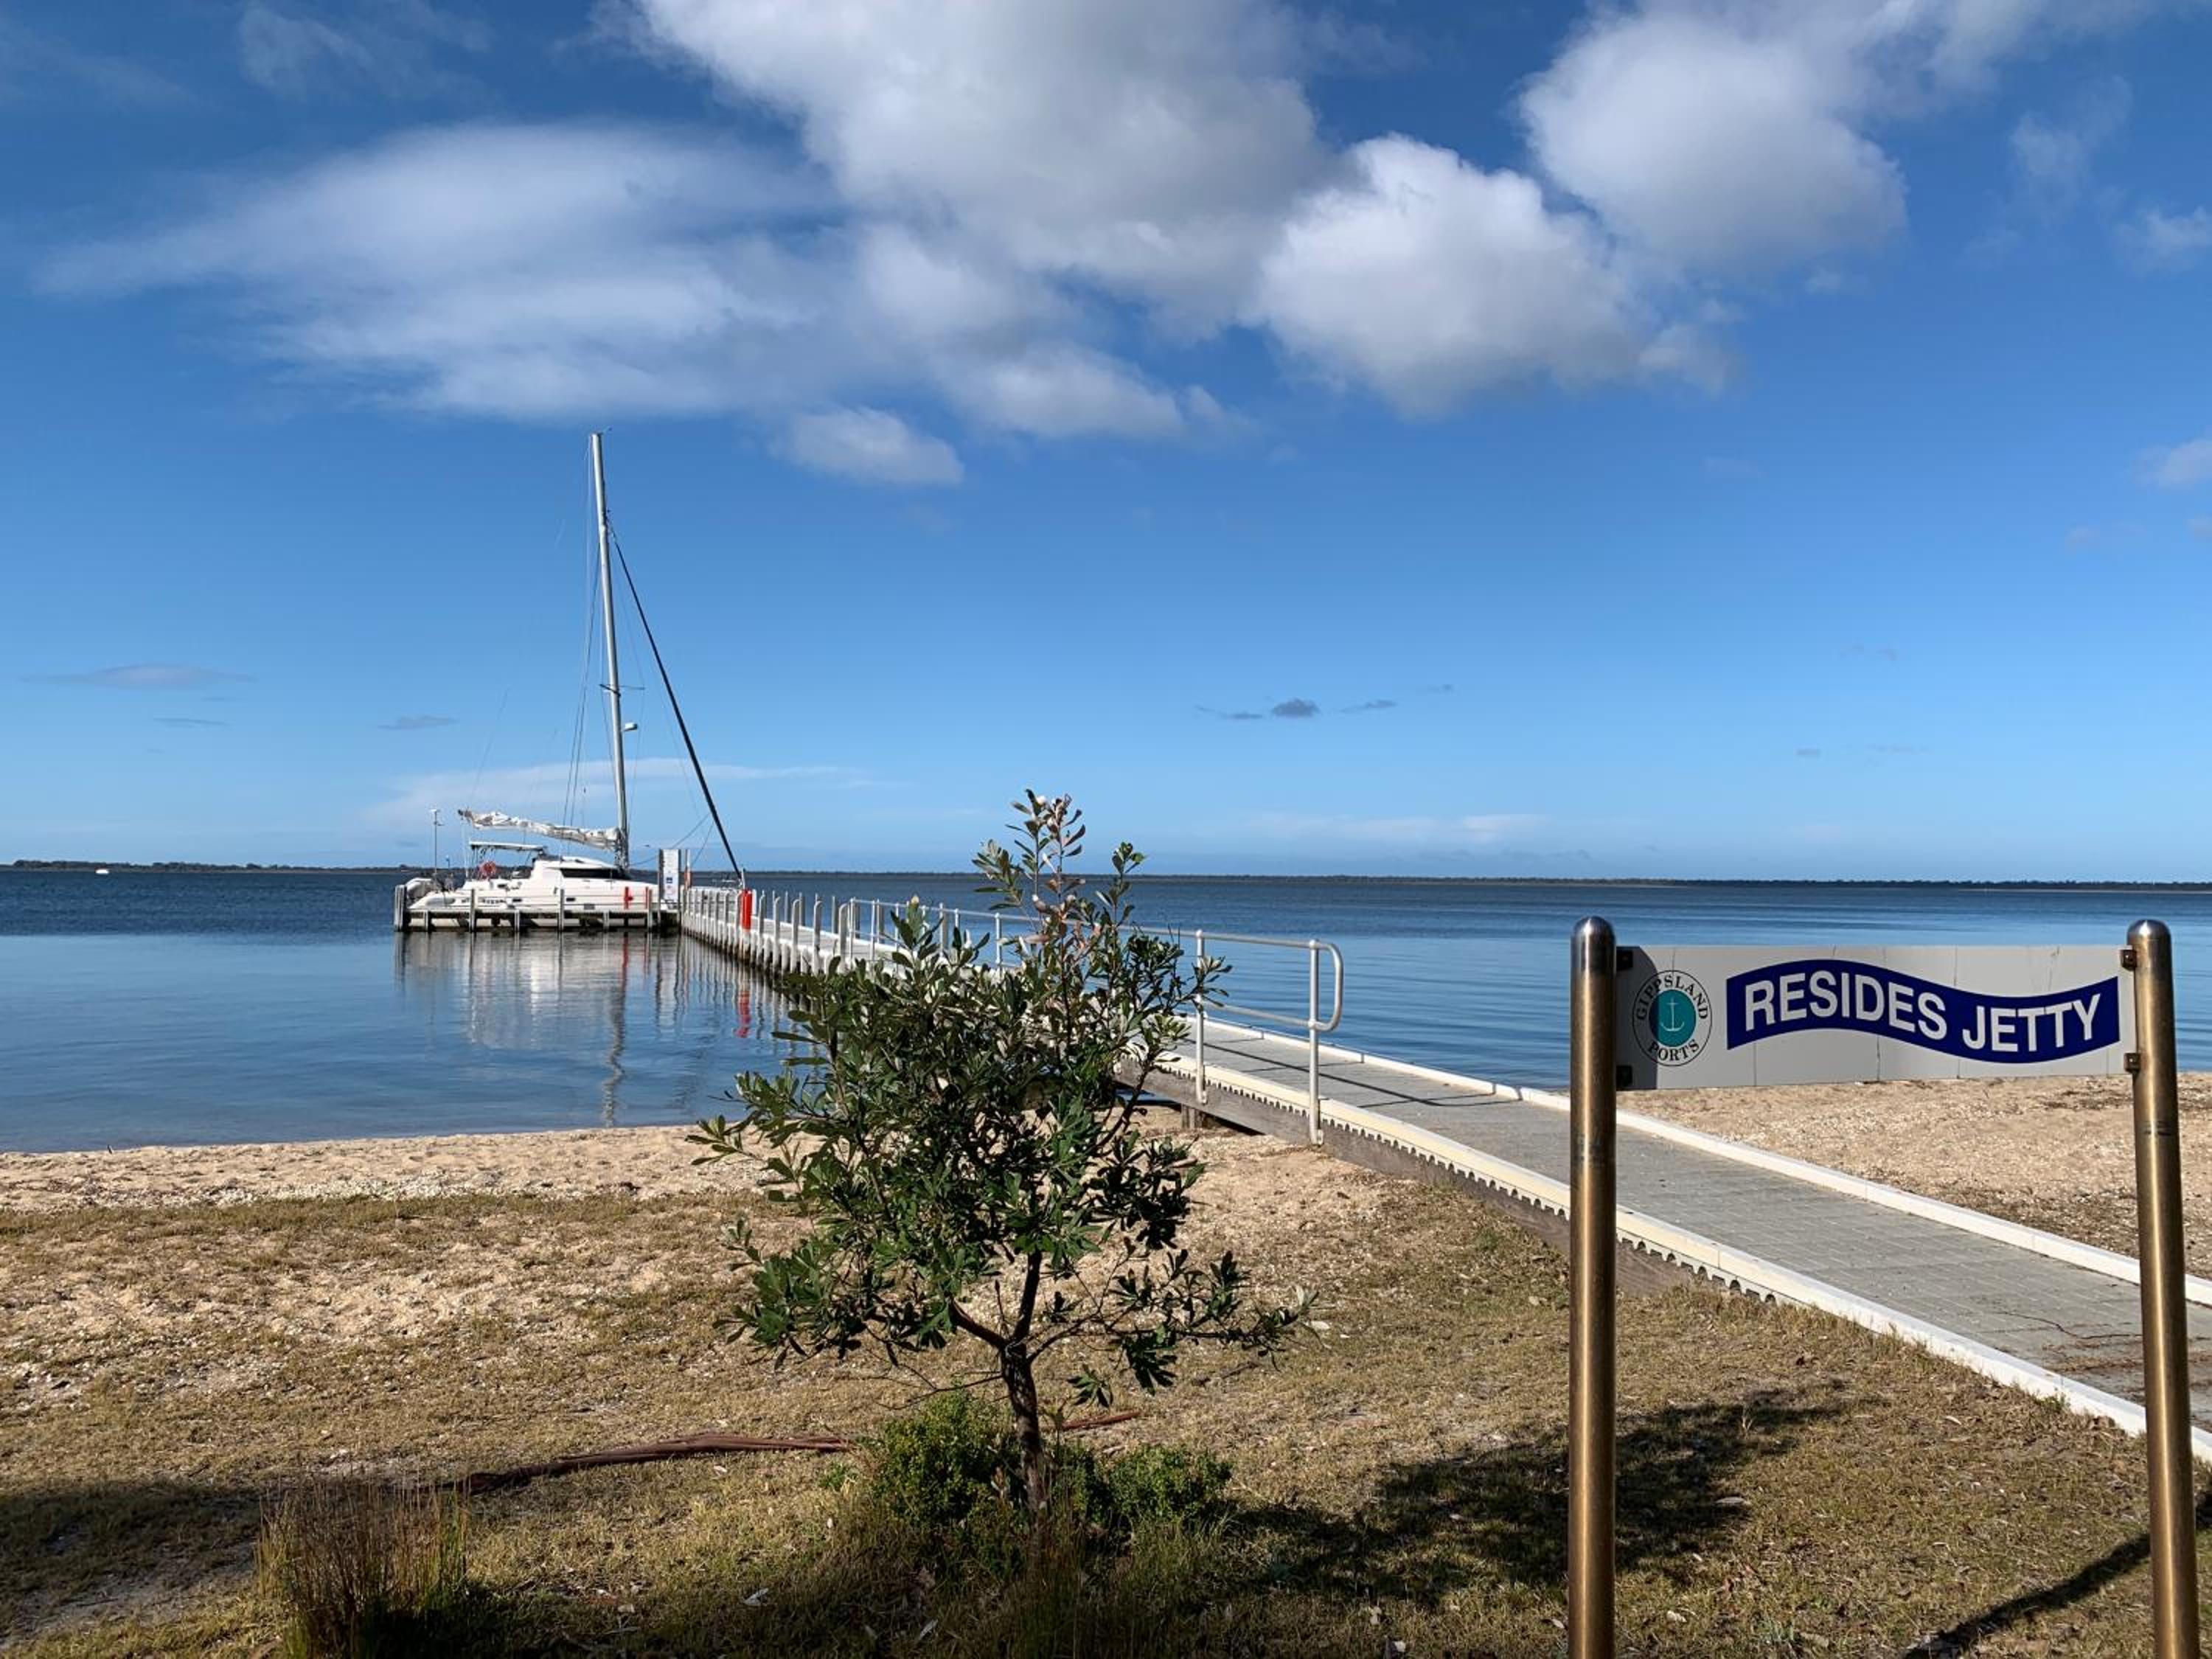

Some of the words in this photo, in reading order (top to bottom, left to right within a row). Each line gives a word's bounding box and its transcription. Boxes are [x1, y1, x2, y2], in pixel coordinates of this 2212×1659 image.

[1636, 974, 1708, 1020] GIPPSLAND
[1745, 970, 1947, 1040] RESIDES
[1962, 993, 2101, 1052] JETTY
[1648, 1039, 1700, 1061] PORTS
